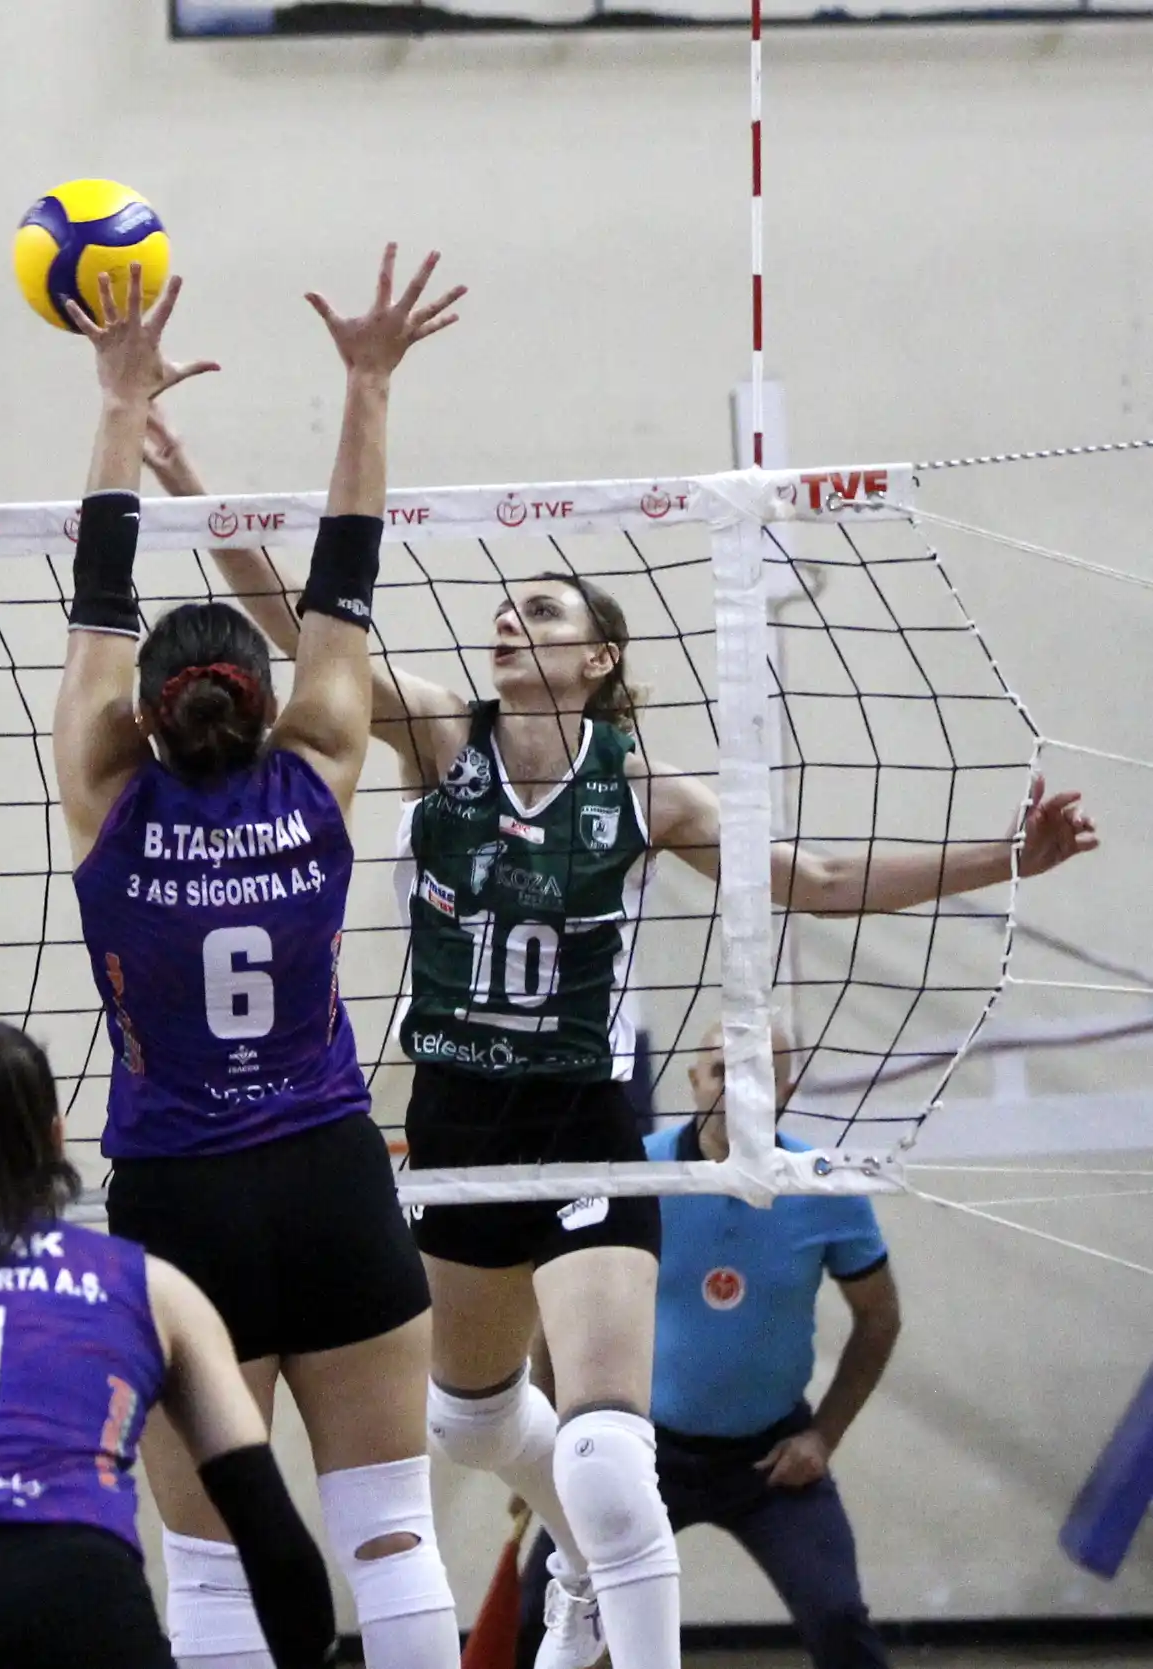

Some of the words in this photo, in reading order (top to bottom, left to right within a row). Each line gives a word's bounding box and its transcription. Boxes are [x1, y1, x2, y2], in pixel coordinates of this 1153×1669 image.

[244, 513, 285, 530] TVF
[388, 508, 430, 524] TVF
[531, 500, 573, 518] TVF
[144, 809, 311, 869] B.TAŞKIRAN
[127, 874, 140, 898] 3
[146, 878, 178, 905] AS
[185, 873, 287, 906] SİGORTA
[292, 860, 326, 894] A.Ş.
[458, 909, 560, 1008] 10
[203, 925, 275, 1041] 6
